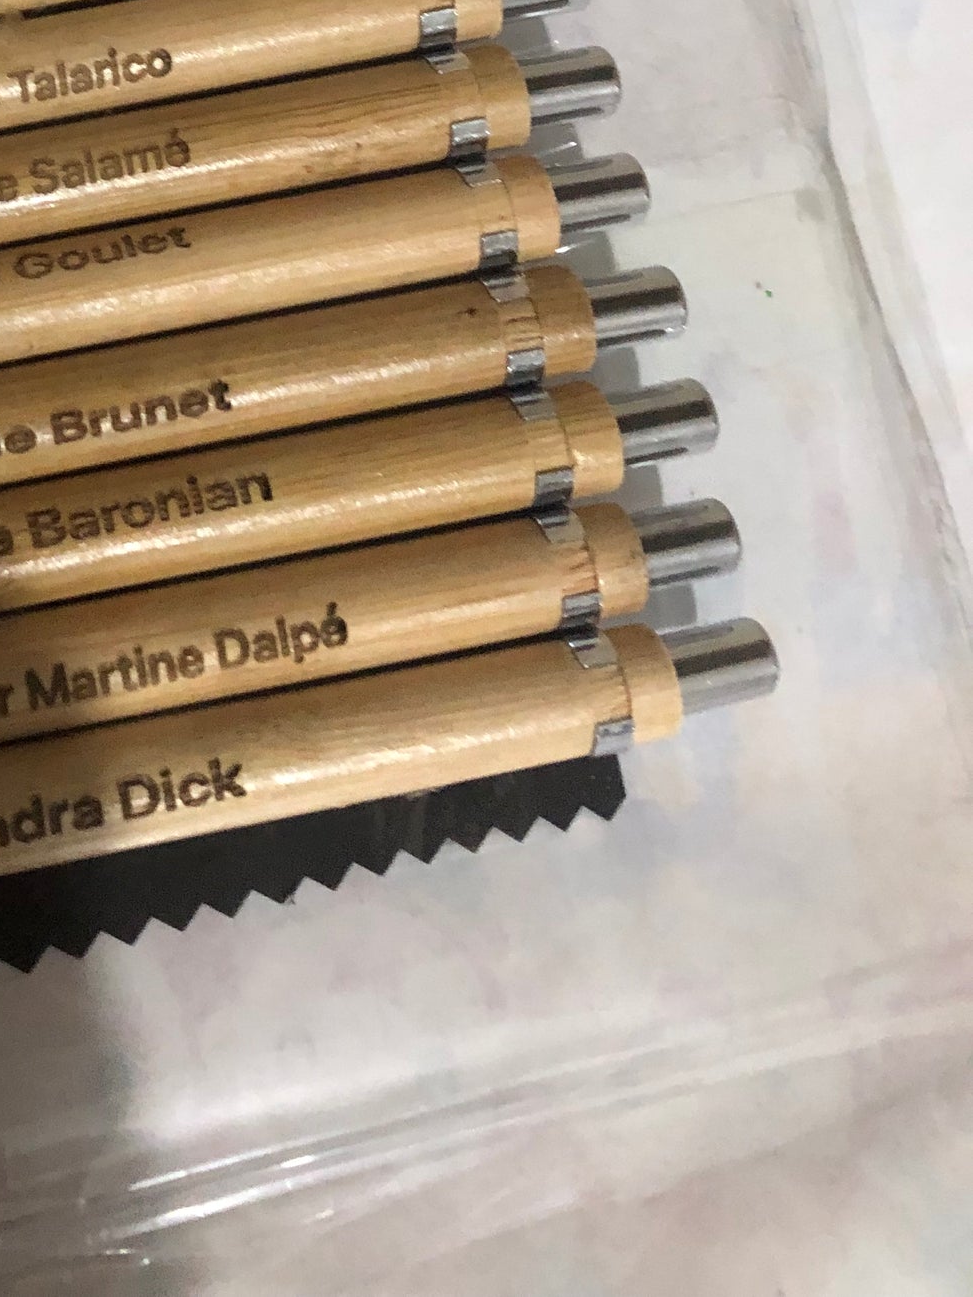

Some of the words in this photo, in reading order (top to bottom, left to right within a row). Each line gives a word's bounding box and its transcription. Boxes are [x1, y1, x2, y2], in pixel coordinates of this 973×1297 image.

[7, 46, 174, 102] Talarico
[28, 128, 192, 195] Salamé
[12, 225, 192, 280] Goulet
[49, 378, 233, 445] Brunet
[26, 469, 275, 550] Baronian
[25, 644, 206, 710] Martine
[212, 602, 349, 673] Dalpé
[116, 756, 248, 822] Dick
